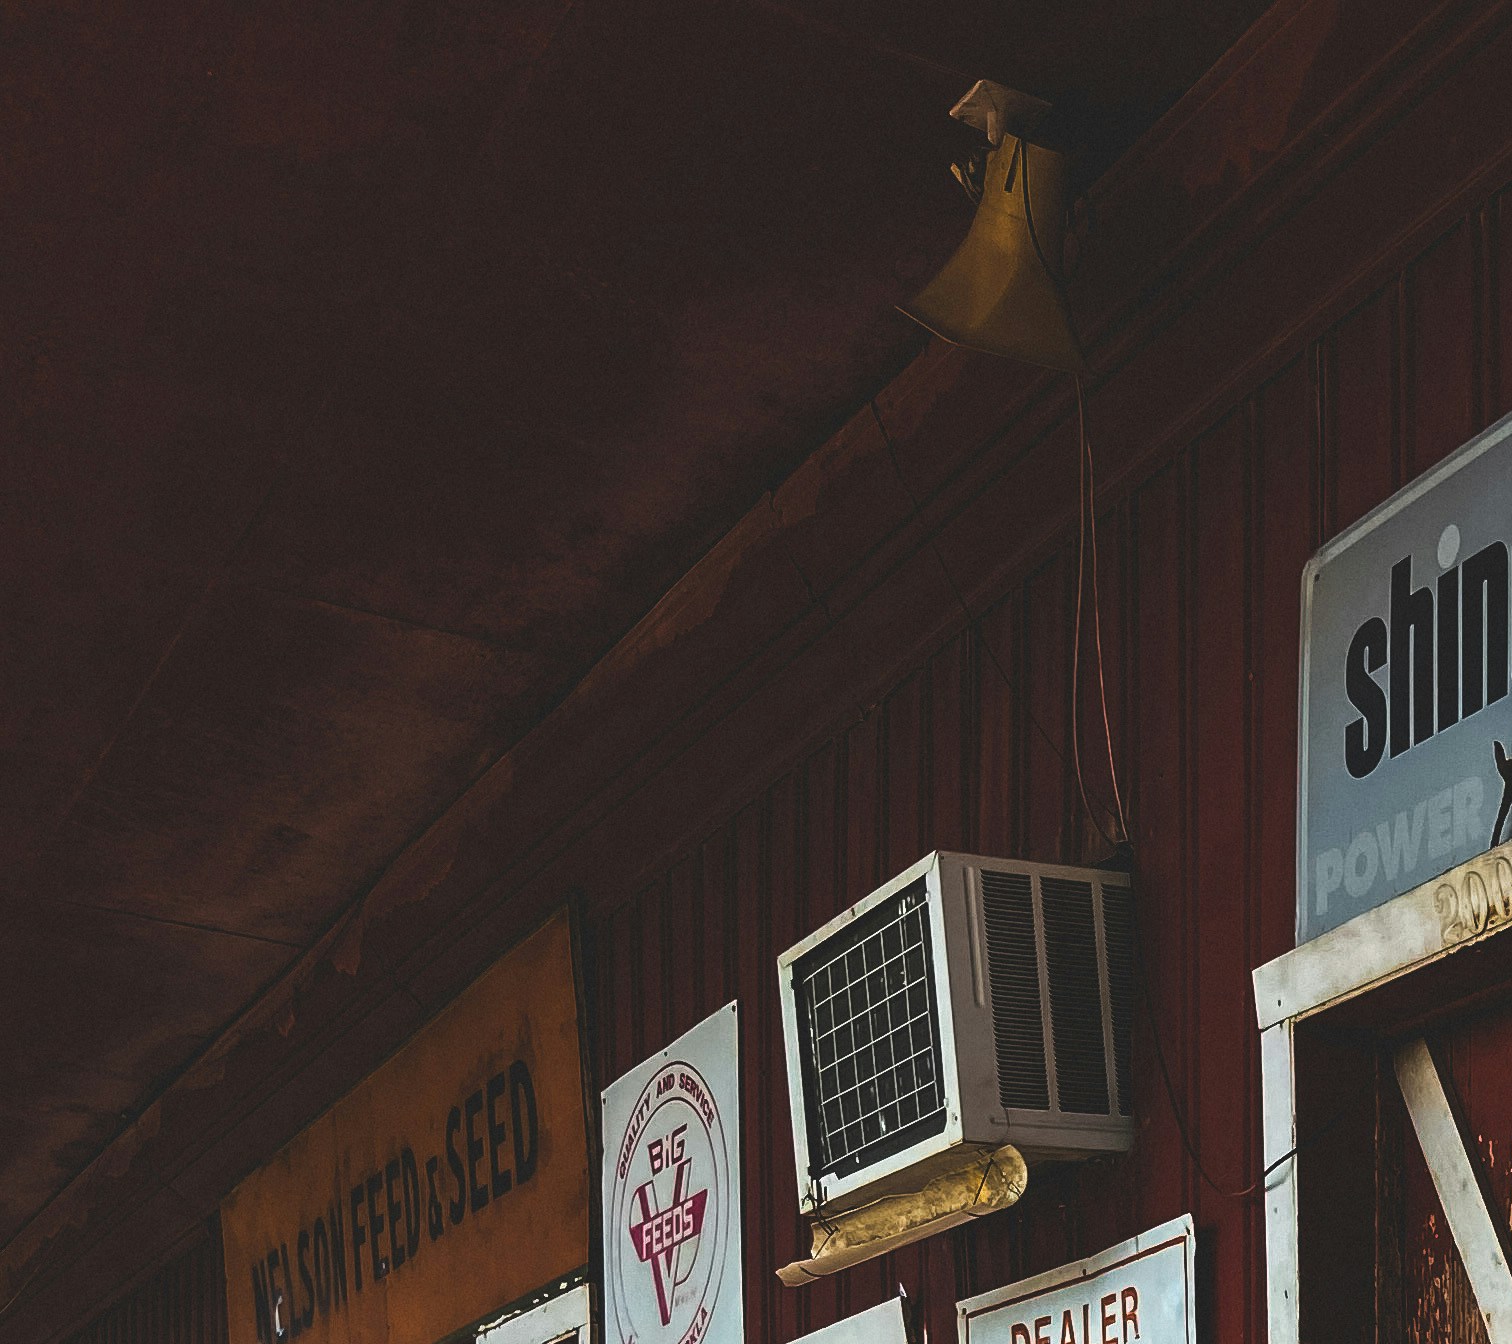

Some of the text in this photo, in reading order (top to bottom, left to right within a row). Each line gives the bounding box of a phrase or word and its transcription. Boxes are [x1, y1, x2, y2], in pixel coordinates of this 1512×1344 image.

[1315, 776, 1484, 916] POWER
[351, 1146, 421, 1292] FEED
[446, 1059, 540, 1226] SEED
[620, 1072, 714, 1180] QUALITY AND SERVICE
[642, 1199, 694, 1259] FEEDS
